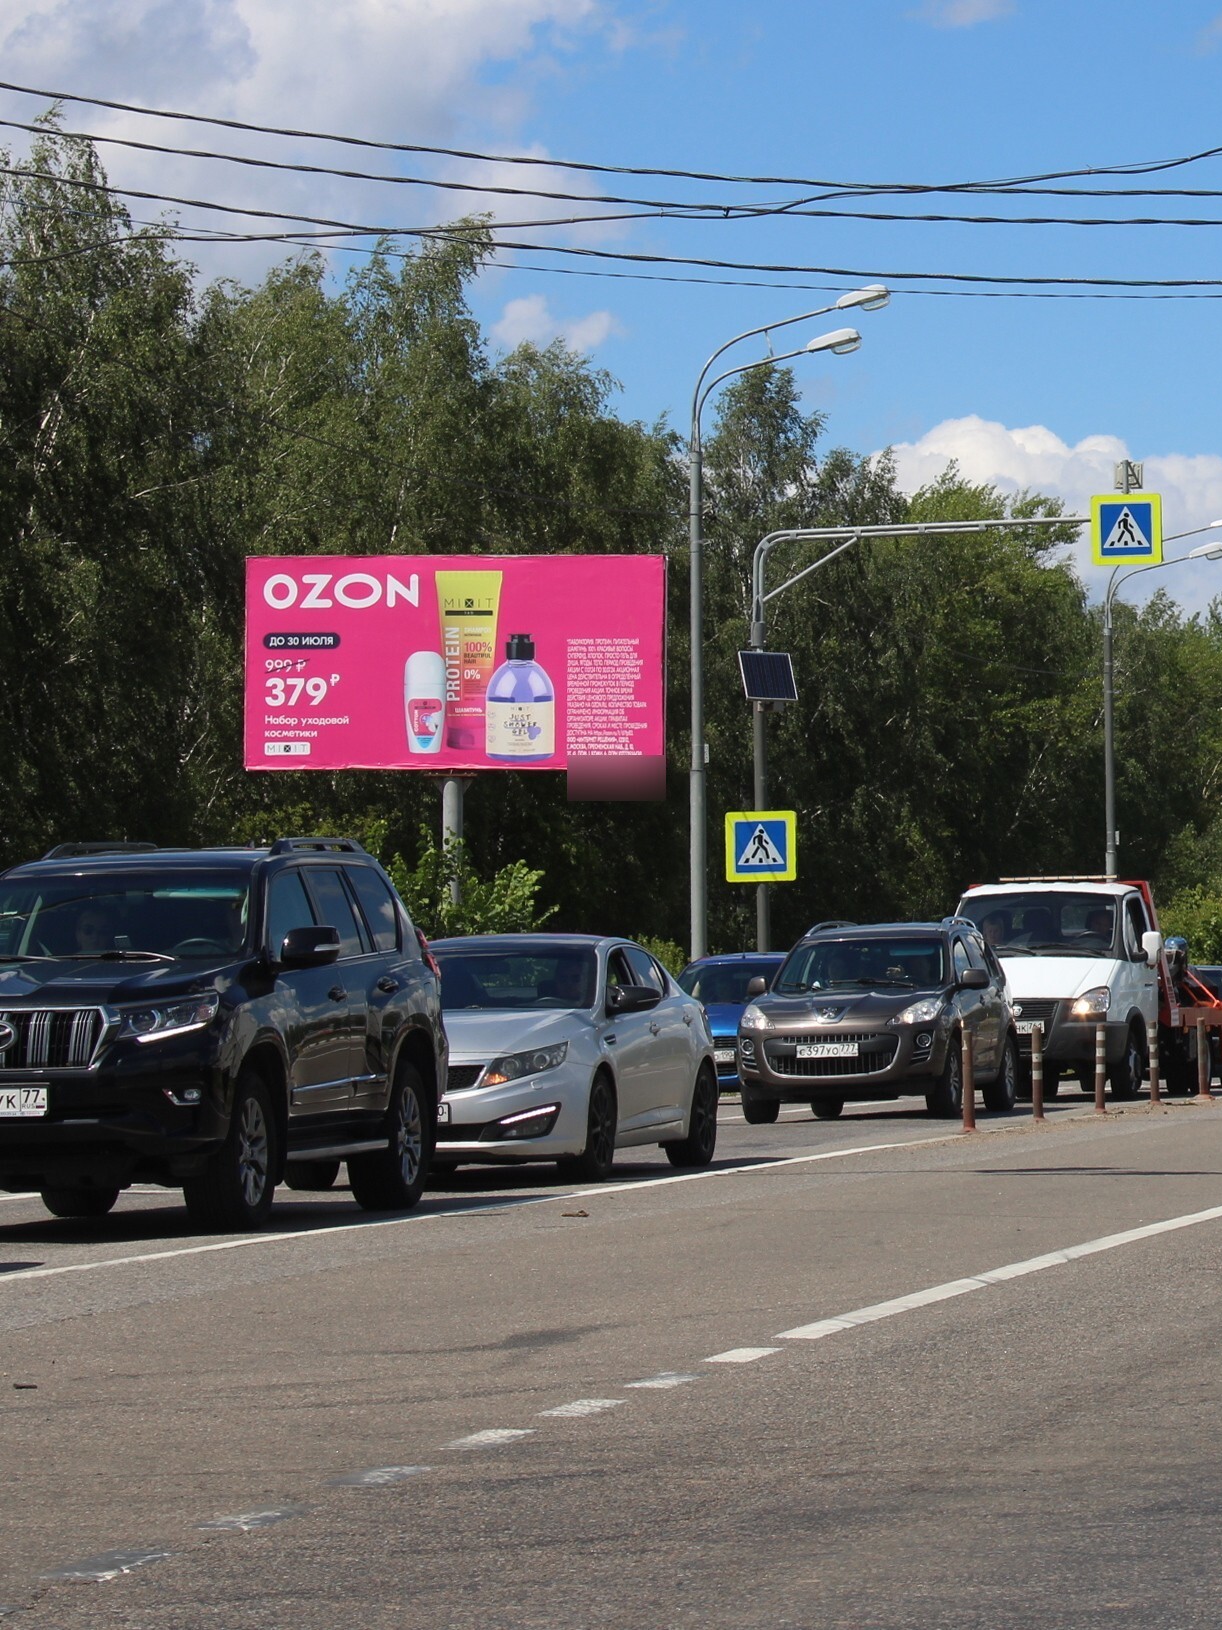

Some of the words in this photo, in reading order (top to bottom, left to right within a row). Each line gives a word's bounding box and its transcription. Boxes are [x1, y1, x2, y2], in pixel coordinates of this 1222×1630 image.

[263, 573, 419, 609] OZON
[269, 637, 285, 647] ДО
[287, 637, 299, 645] 30
[302, 637, 334, 646] ИЮЛЯ
[464, 642, 492, 653] 100%
[265, 659, 292, 672] 999
[445, 627, 460, 702] PROTEIN
[464, 669, 480, 679] 0%
[265, 677, 327, 706] 379
[264, 715, 298, 725] Набор
[301, 715, 349, 726] уходовой
[264, 730, 318, 738] косметики
[22, 1090, 40, 1104] 77
